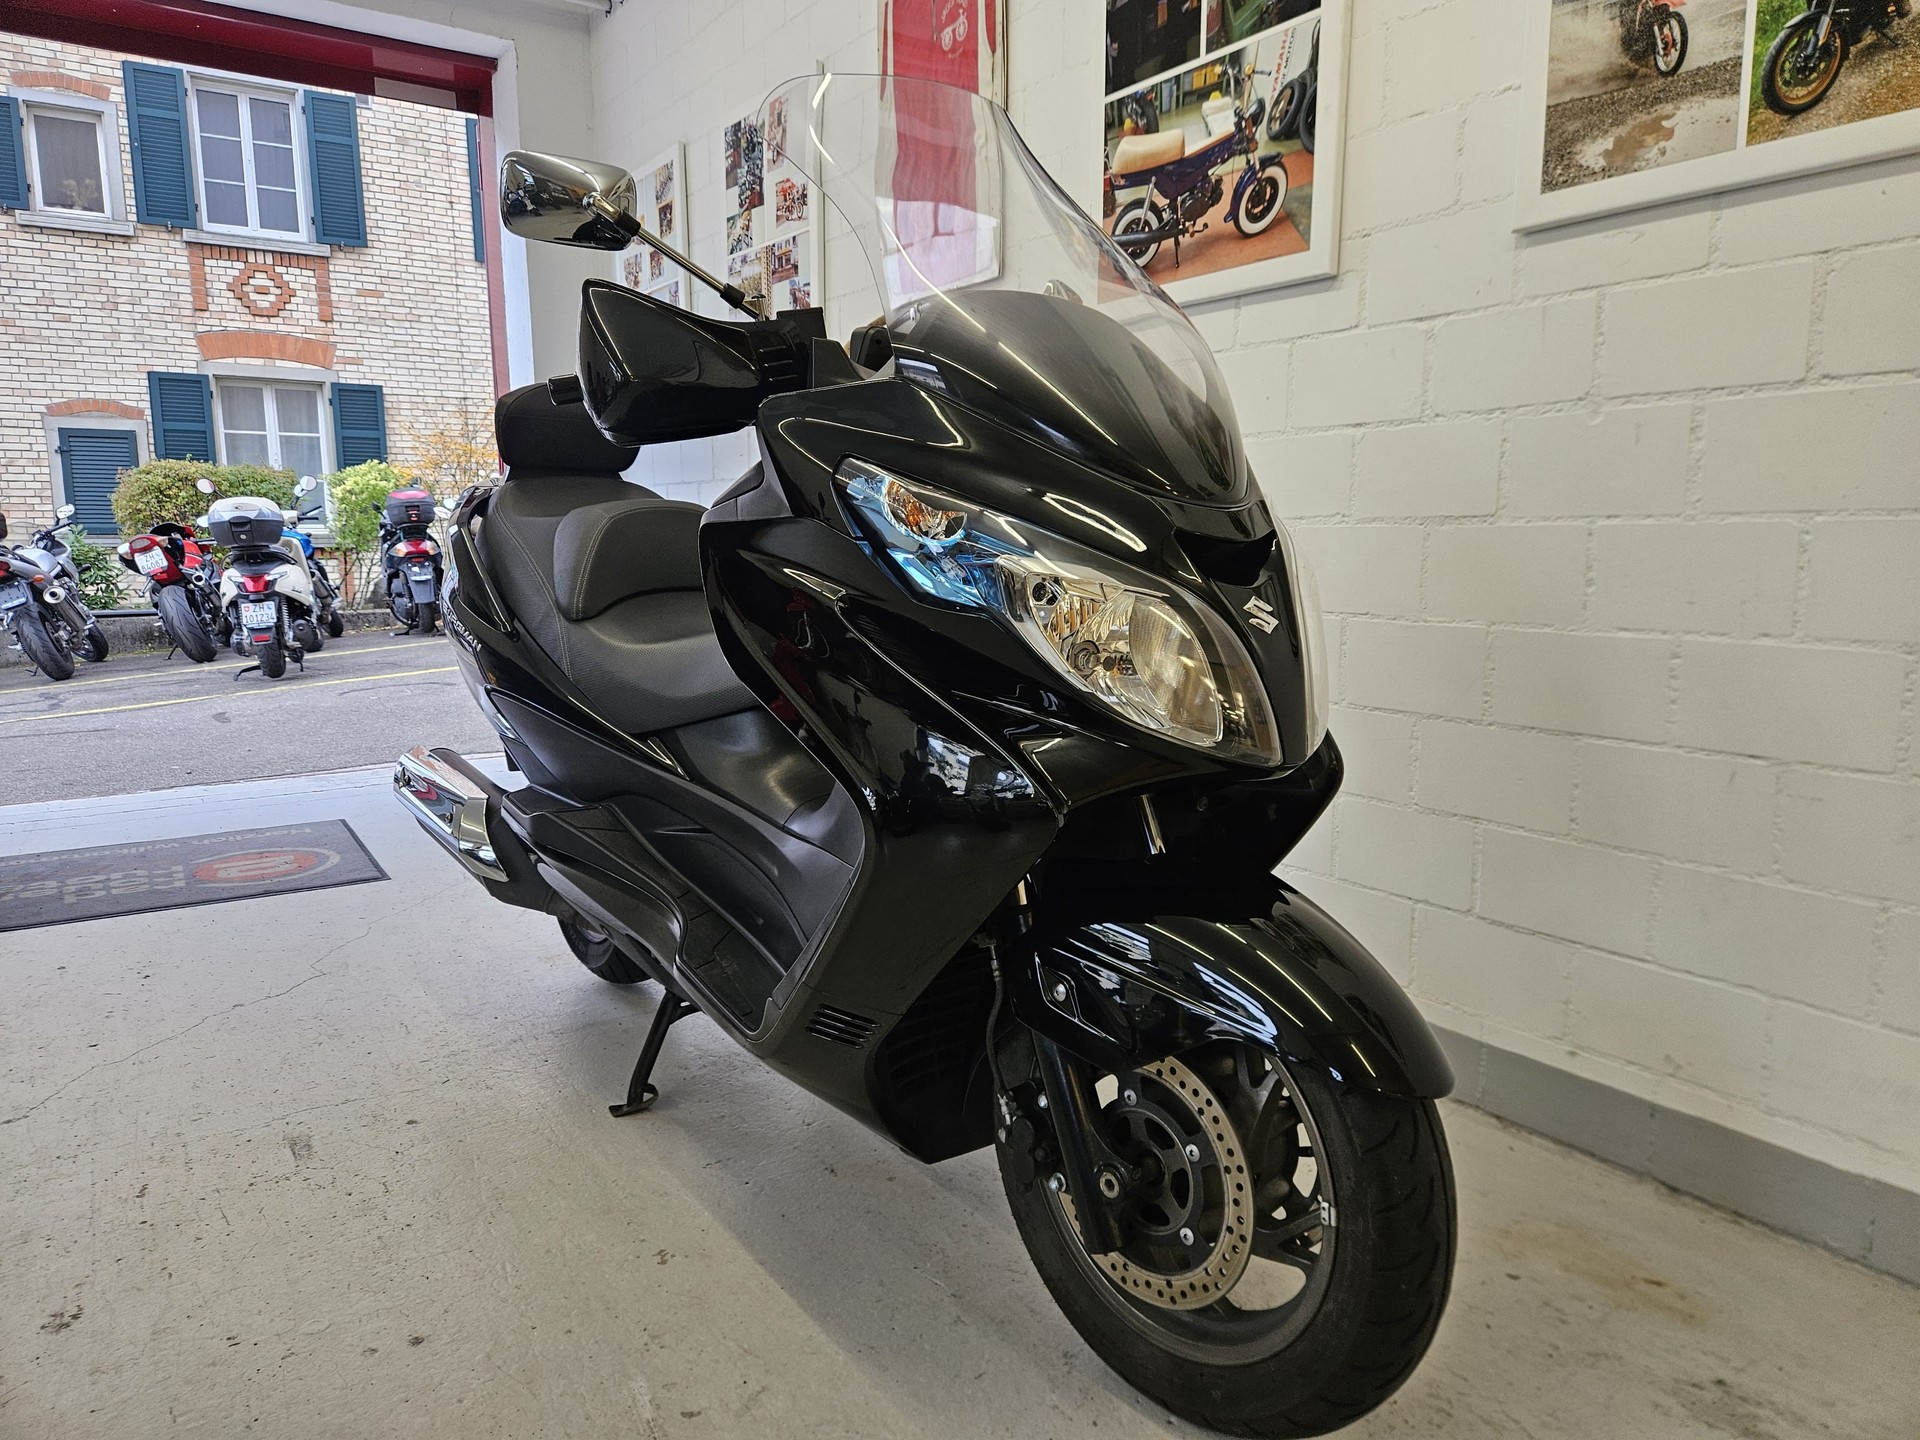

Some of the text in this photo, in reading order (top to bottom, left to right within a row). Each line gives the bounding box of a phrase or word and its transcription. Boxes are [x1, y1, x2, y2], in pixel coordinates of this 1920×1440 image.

[1272, 27, 1291, 93] YAMAHA
[143, 553, 156, 563] ZH
[140, 558, 164, 573] 84087
[252, 603, 265, 613] ZH
[244, 612, 275, 624] 101234
[0, 843, 180, 867] willkomme
